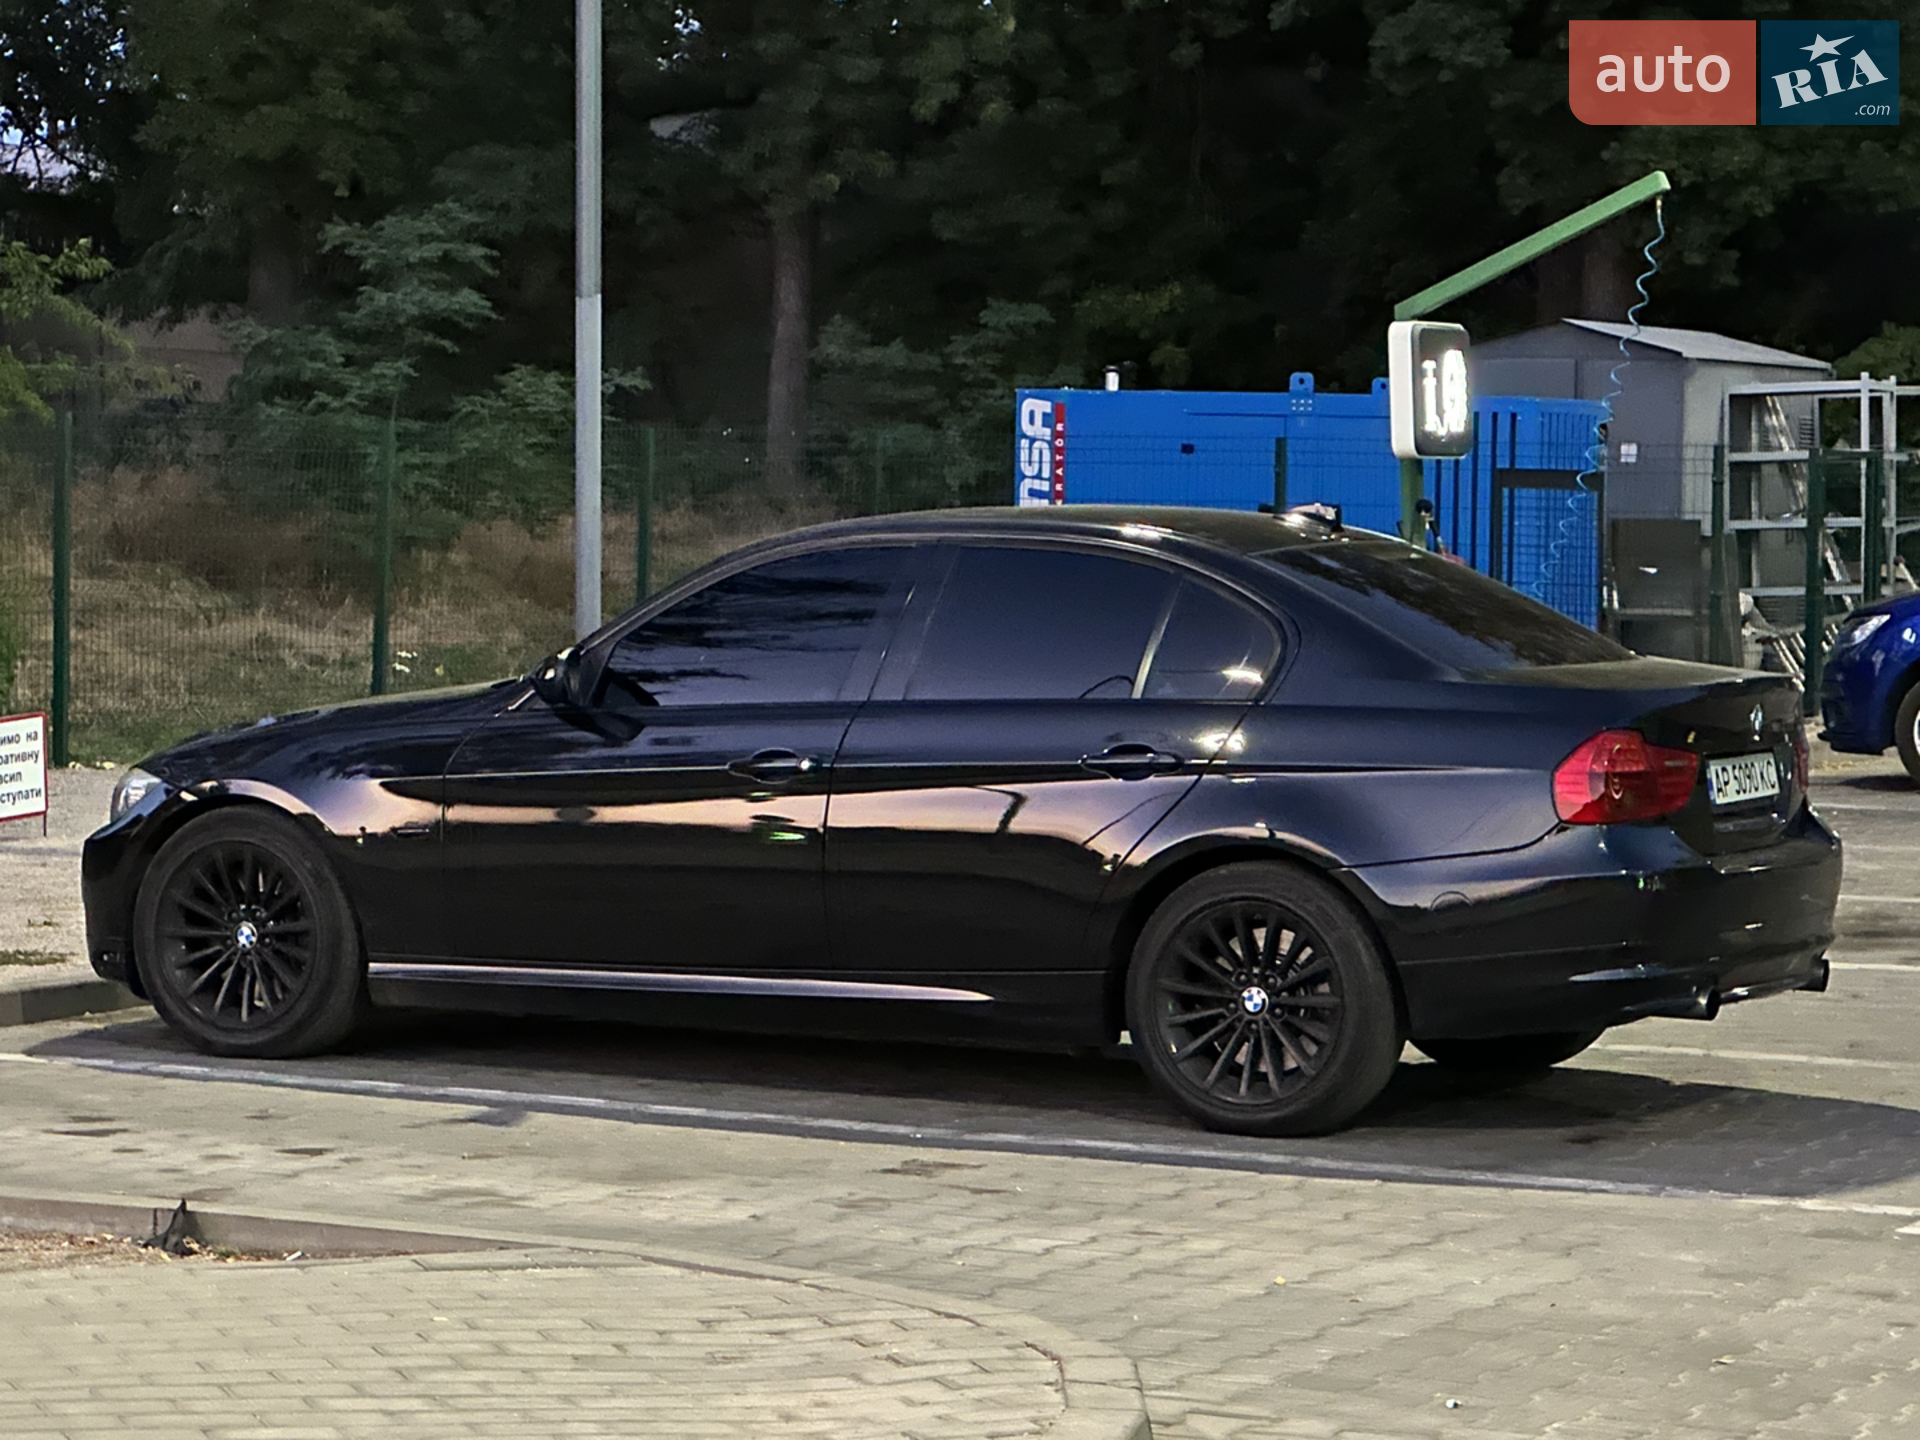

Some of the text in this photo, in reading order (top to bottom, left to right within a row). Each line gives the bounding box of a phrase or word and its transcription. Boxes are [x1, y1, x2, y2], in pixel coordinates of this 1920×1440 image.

[26, 730, 38, 742] на
[1715, 766, 1730, 798] AP
[1760, 759, 1776, 790] KC
